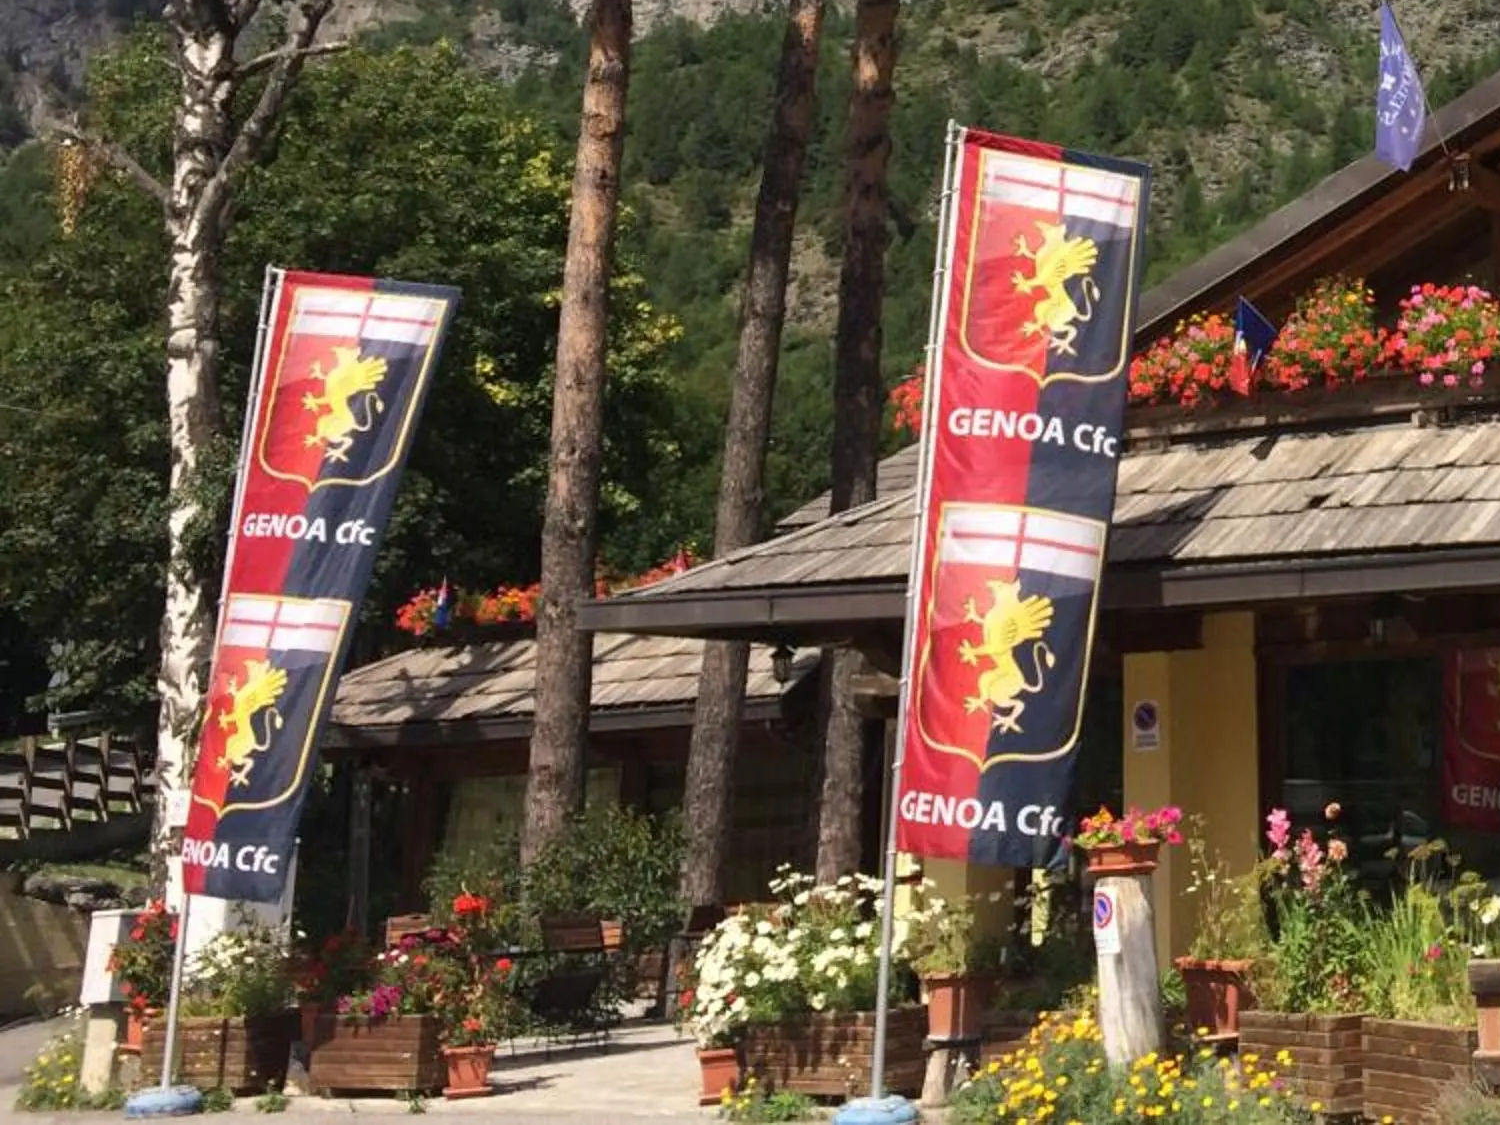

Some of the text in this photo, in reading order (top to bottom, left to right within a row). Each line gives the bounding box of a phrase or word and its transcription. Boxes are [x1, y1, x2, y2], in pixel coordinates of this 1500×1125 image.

[947, 406, 1118, 458] GENOA Cfc
[243, 512, 327, 543] GENOA
[900, 790, 1007, 832] GENOA
[182, 837, 229, 869] ENOA
